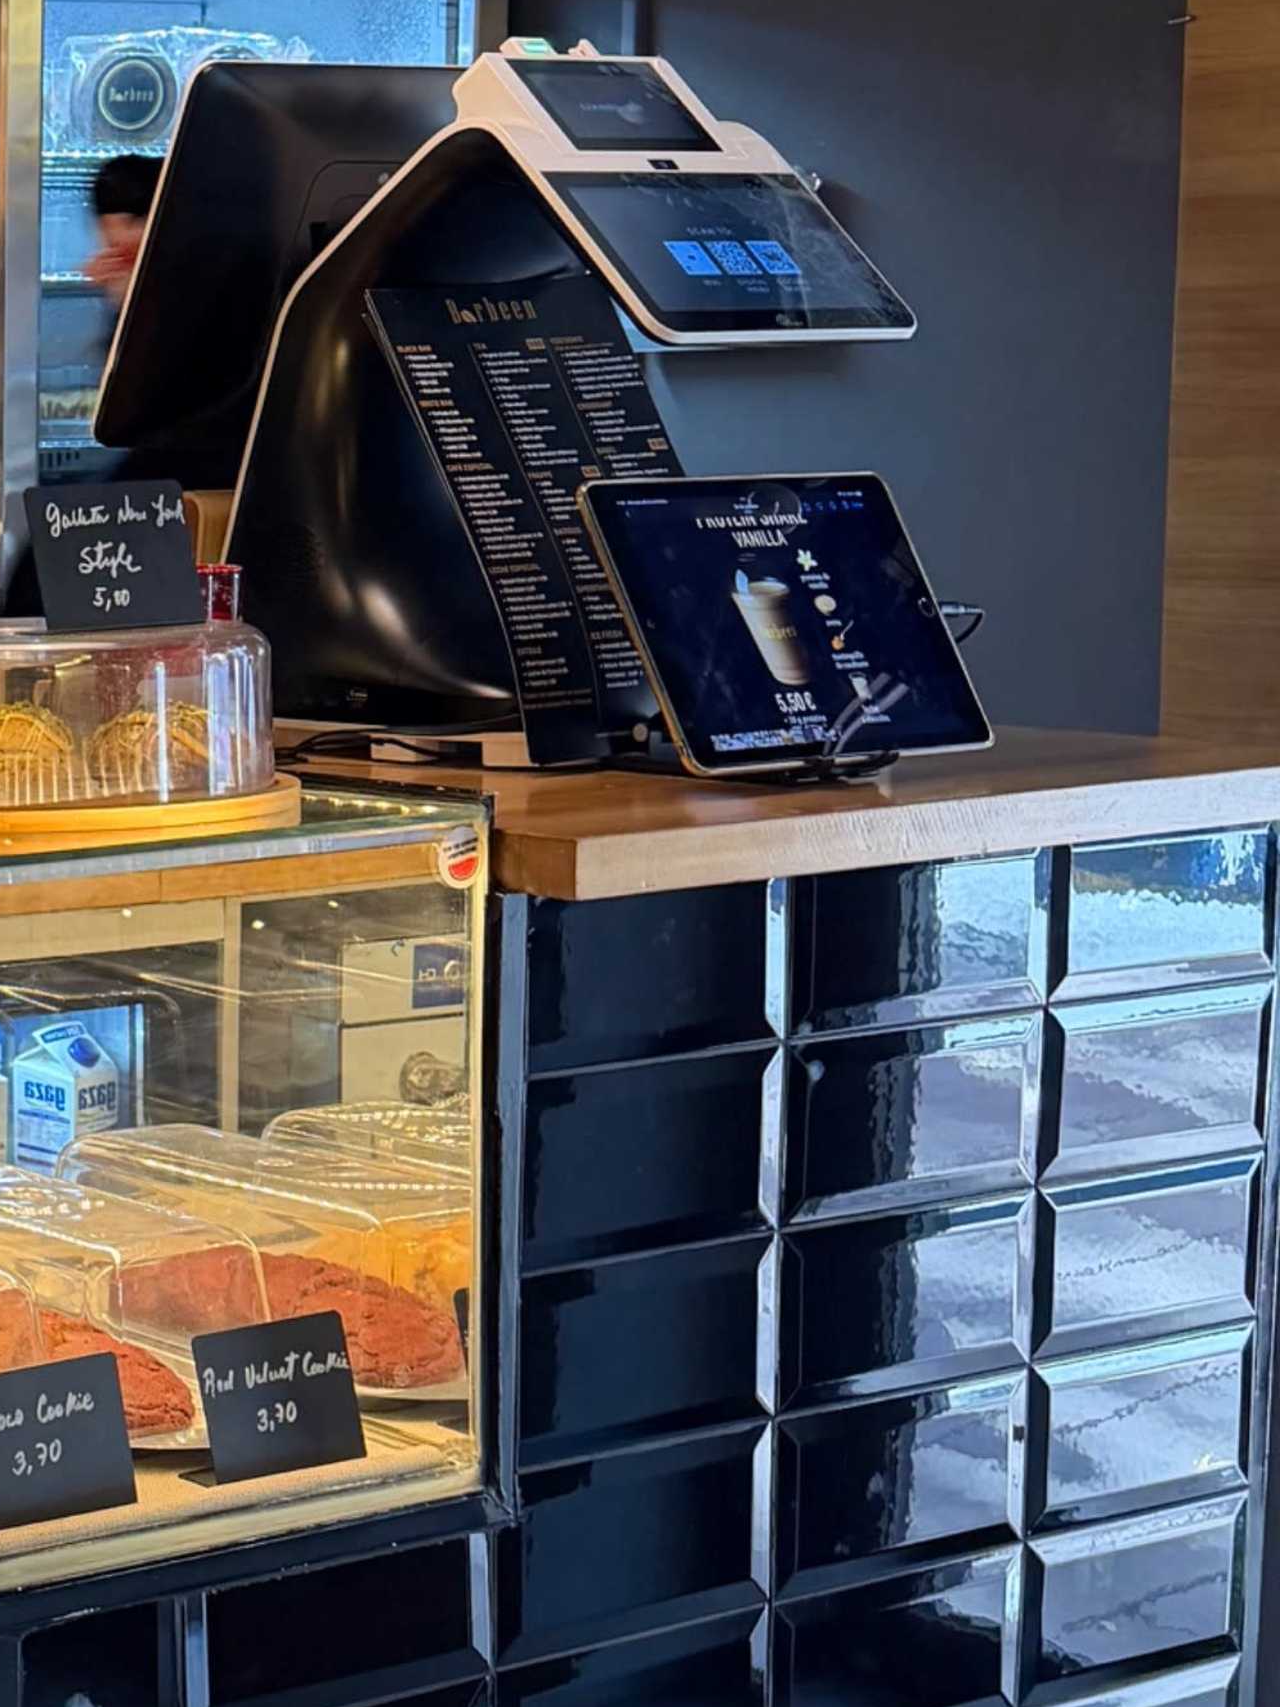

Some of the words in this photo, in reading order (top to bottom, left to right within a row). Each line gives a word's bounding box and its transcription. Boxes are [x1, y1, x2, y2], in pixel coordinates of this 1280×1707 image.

[445, 297, 537, 324] Barbeen
[732, 529, 788, 547] VANILLA
[35, 1390, 96, 1425] Cookie
[255, 1400, 299, 1435] 3,70
[11, 1438, 63, 1478] 3,70
